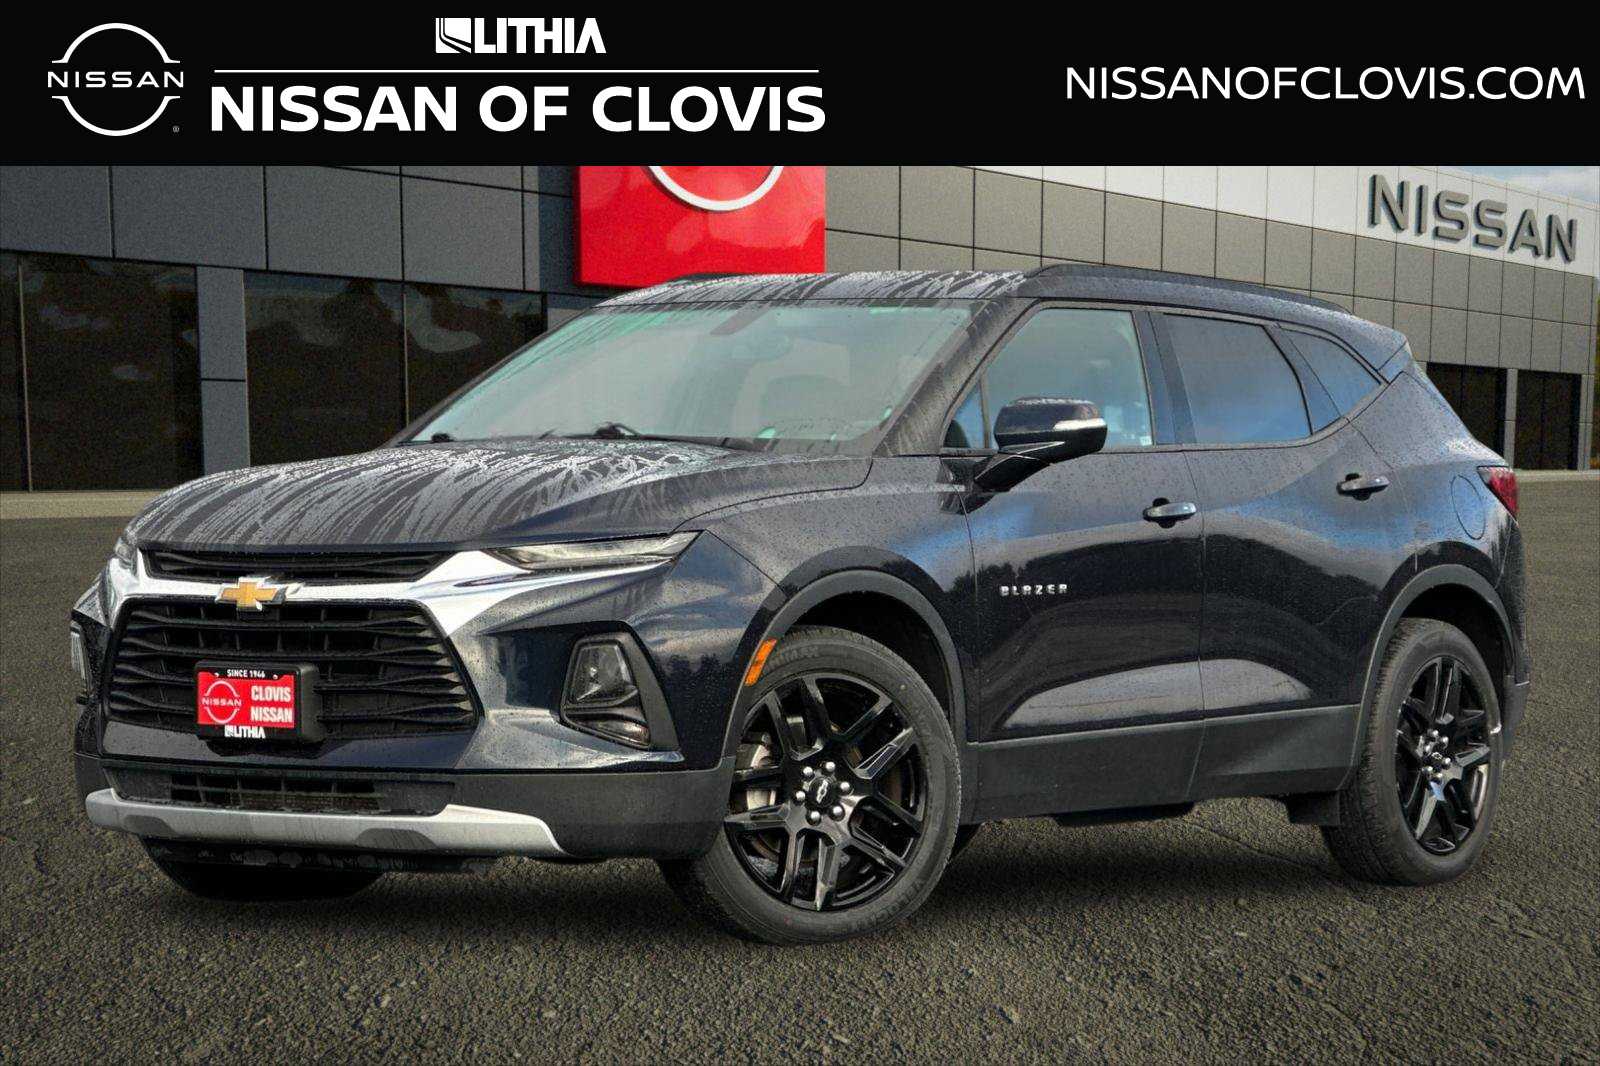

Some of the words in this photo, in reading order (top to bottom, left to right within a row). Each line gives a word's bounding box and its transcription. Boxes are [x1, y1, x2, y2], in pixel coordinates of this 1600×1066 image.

[1368, 174, 1577, 263] NISSAN
[1000, 583, 1068, 597] BLAZER
[227, 669, 248, 678] SINCE
[251, 685, 291, 702] CLOVIS
[202, 697, 241, 706] NISSAN
[250, 706, 293, 722] NISSAN
[234, 725, 266, 739] LITHIA
